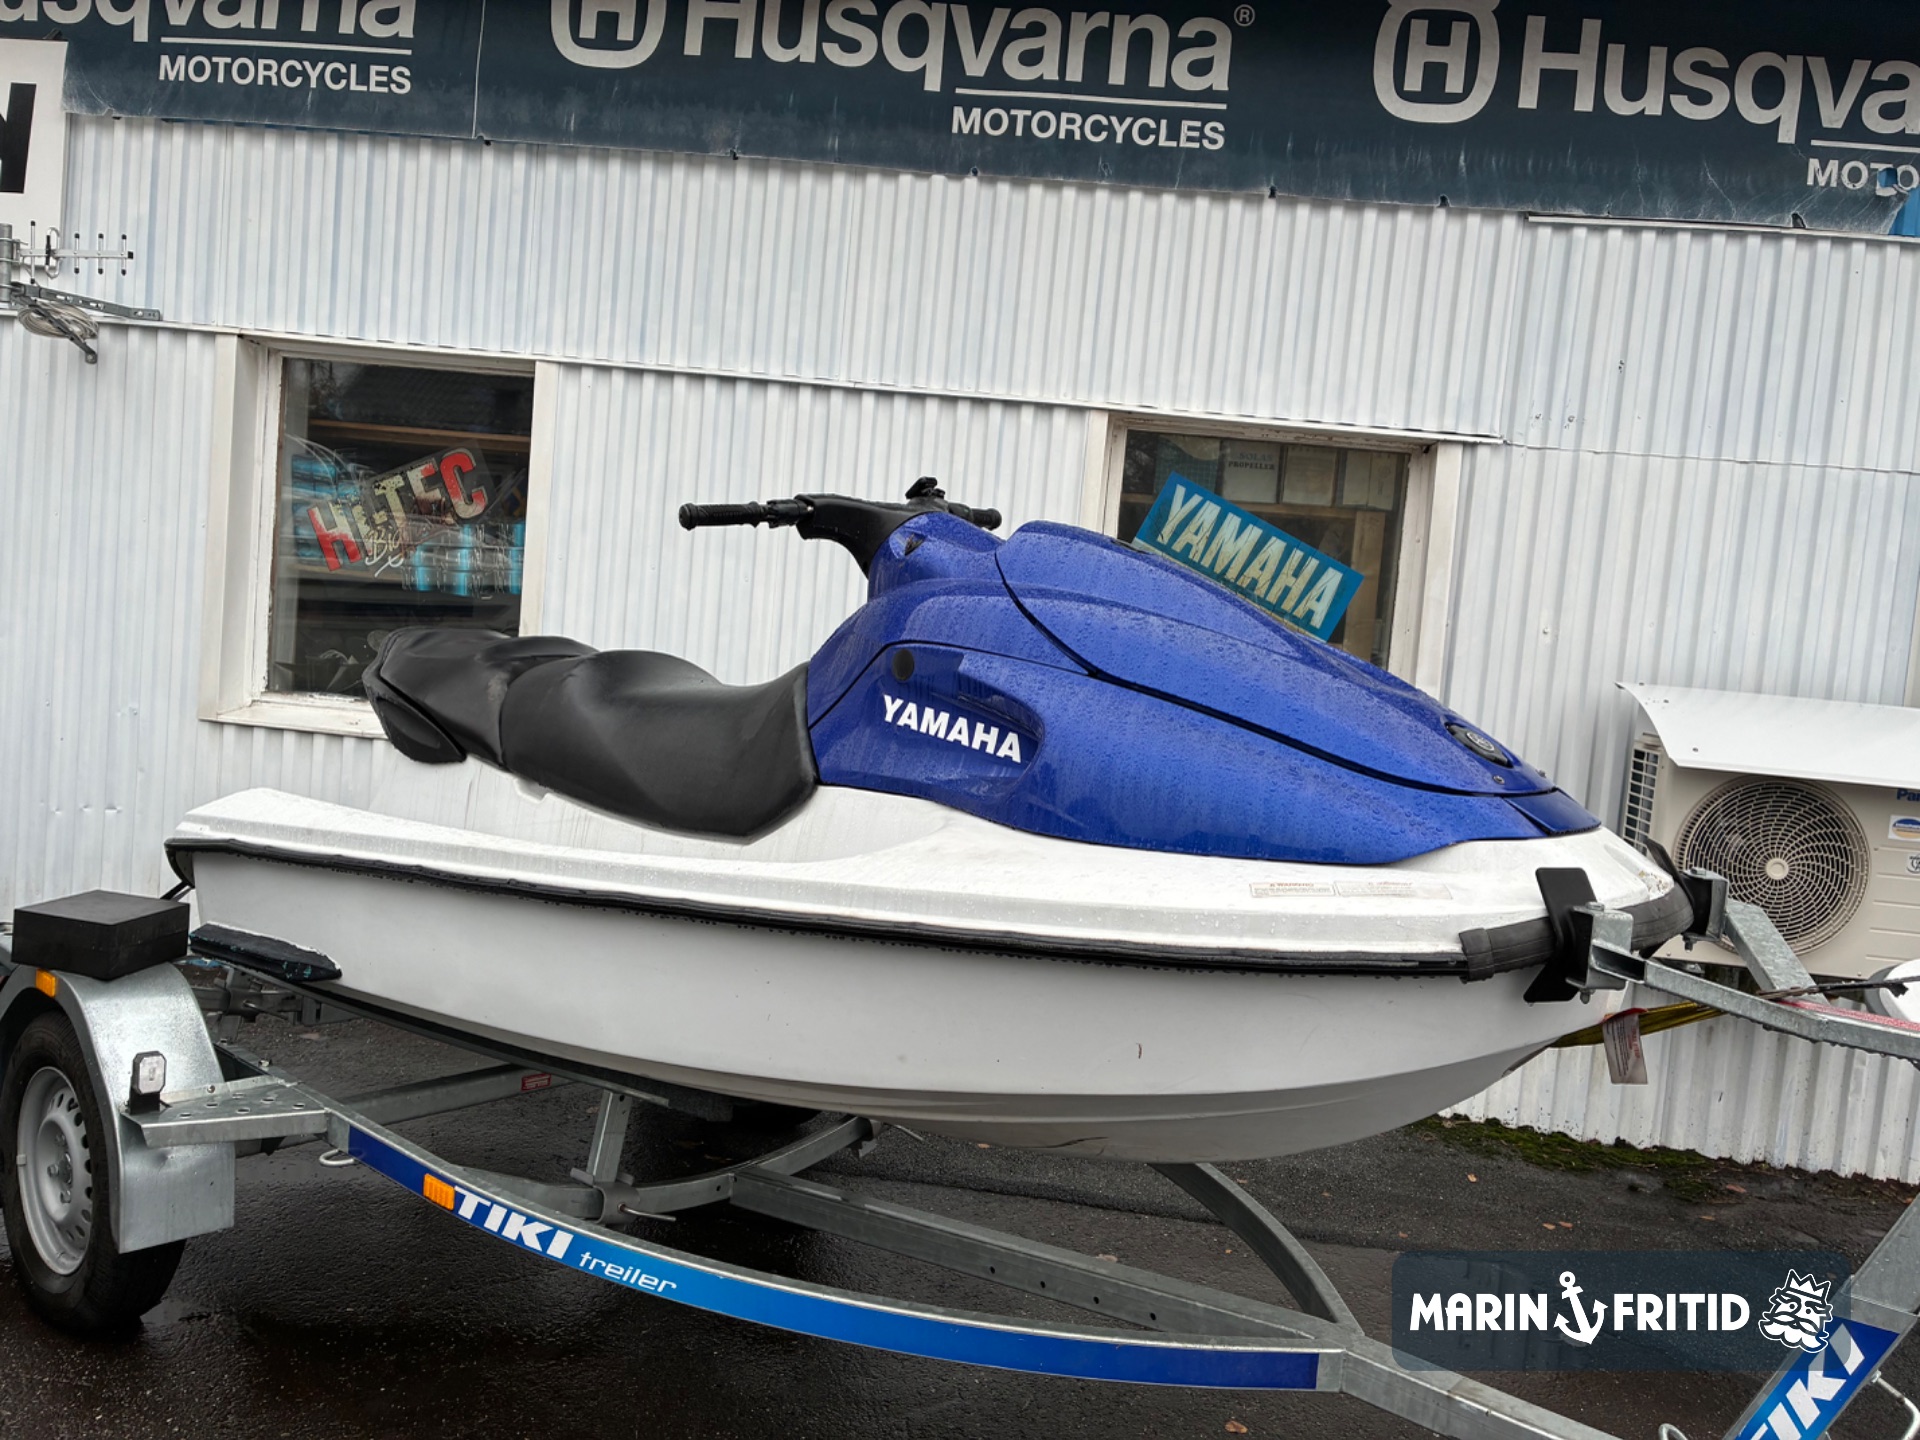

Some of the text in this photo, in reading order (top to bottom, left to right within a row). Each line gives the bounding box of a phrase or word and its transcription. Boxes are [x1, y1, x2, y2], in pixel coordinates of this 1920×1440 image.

[158, 54, 411, 94] MOTORCYCLES
[683, 0, 1232, 92] Husqvarna
[1518, 15, 1920, 144] Husqva
[951, 106, 1226, 150] MOTORCYCLES
[1228, 461, 1276, 470] PROPELLER
[1157, 484, 1343, 628] YAMAHA
[883, 694, 1021, 764] YAMAHA
[454, 1185, 677, 1293] TIKI treiler
[1750, 1323, 1865, 1440] IKI
